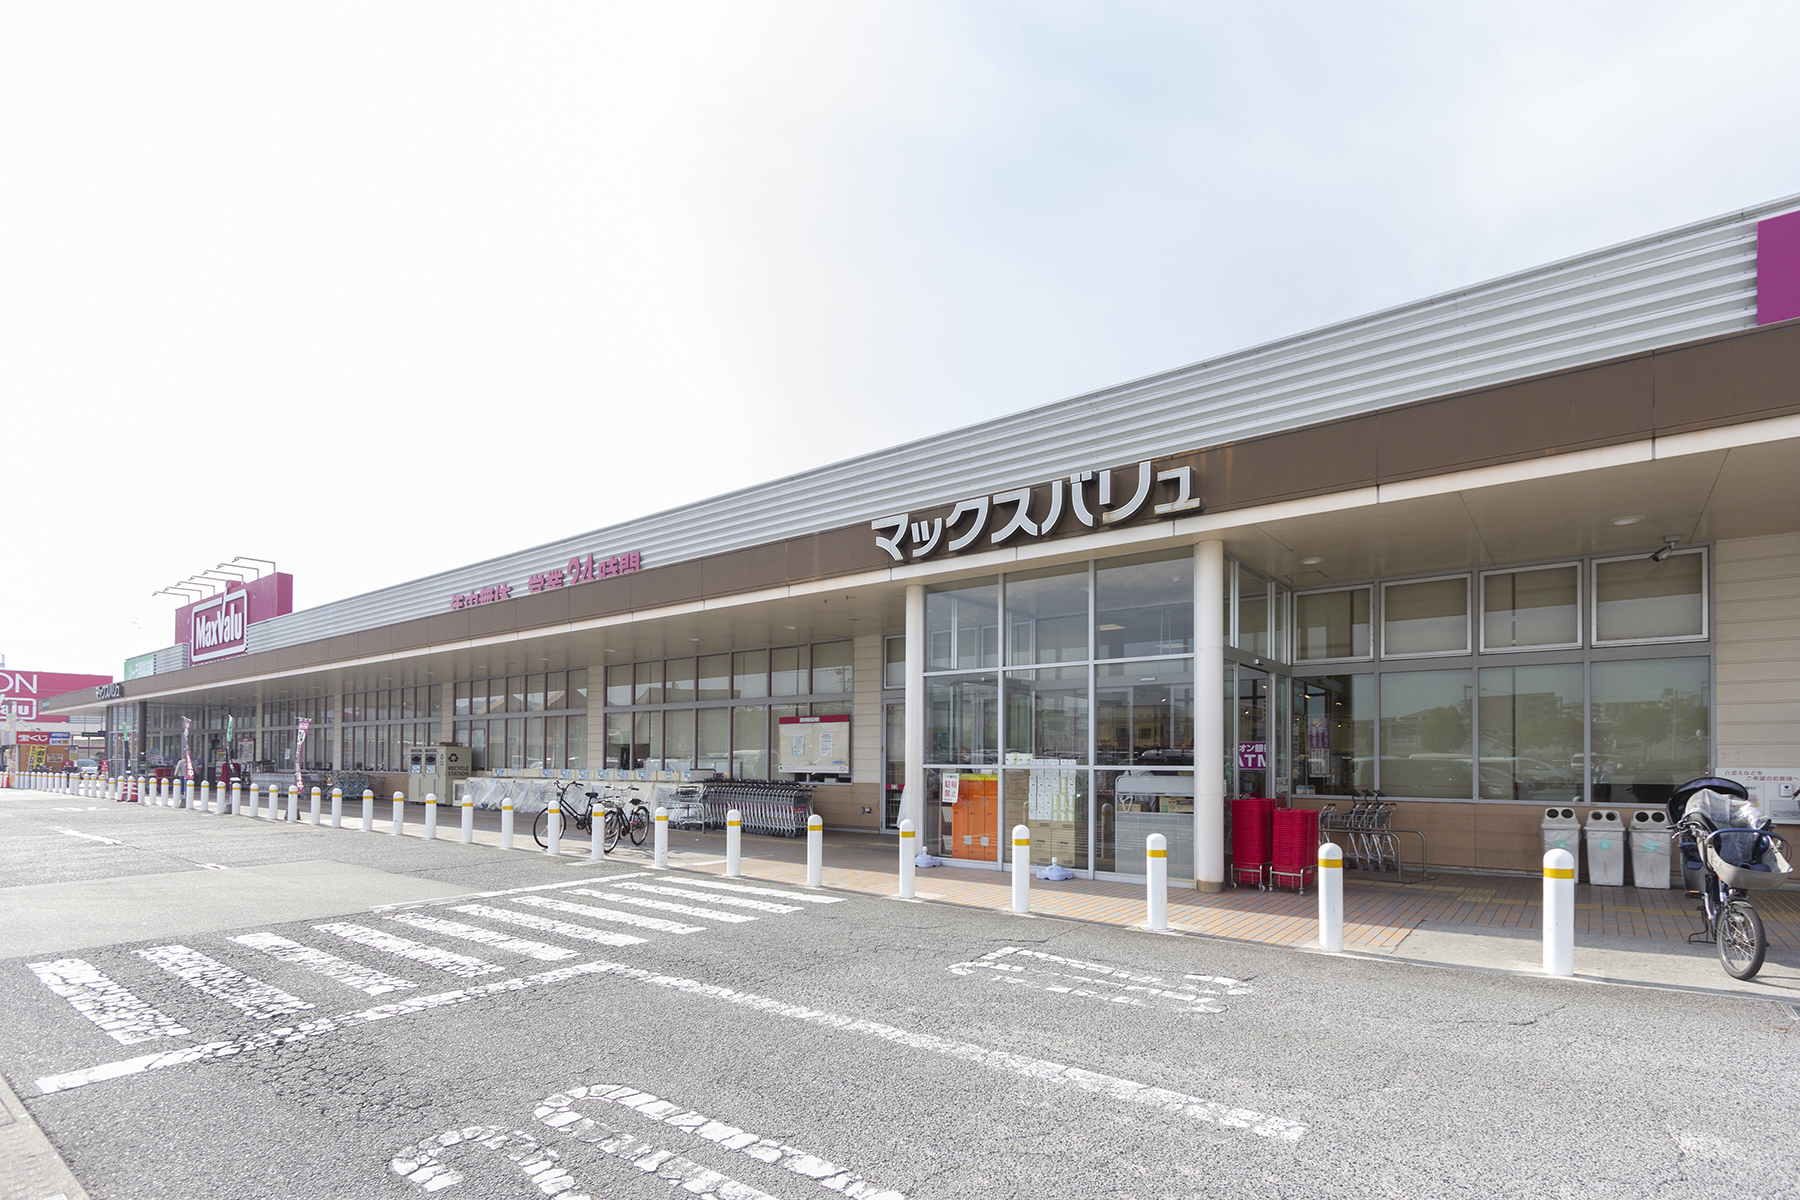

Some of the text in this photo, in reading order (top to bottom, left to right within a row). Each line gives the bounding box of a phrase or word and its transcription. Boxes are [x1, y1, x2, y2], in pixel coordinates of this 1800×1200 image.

[871, 460, 1203, 562] マックスバリュ
[195, 587, 243, 650] MaxValu
